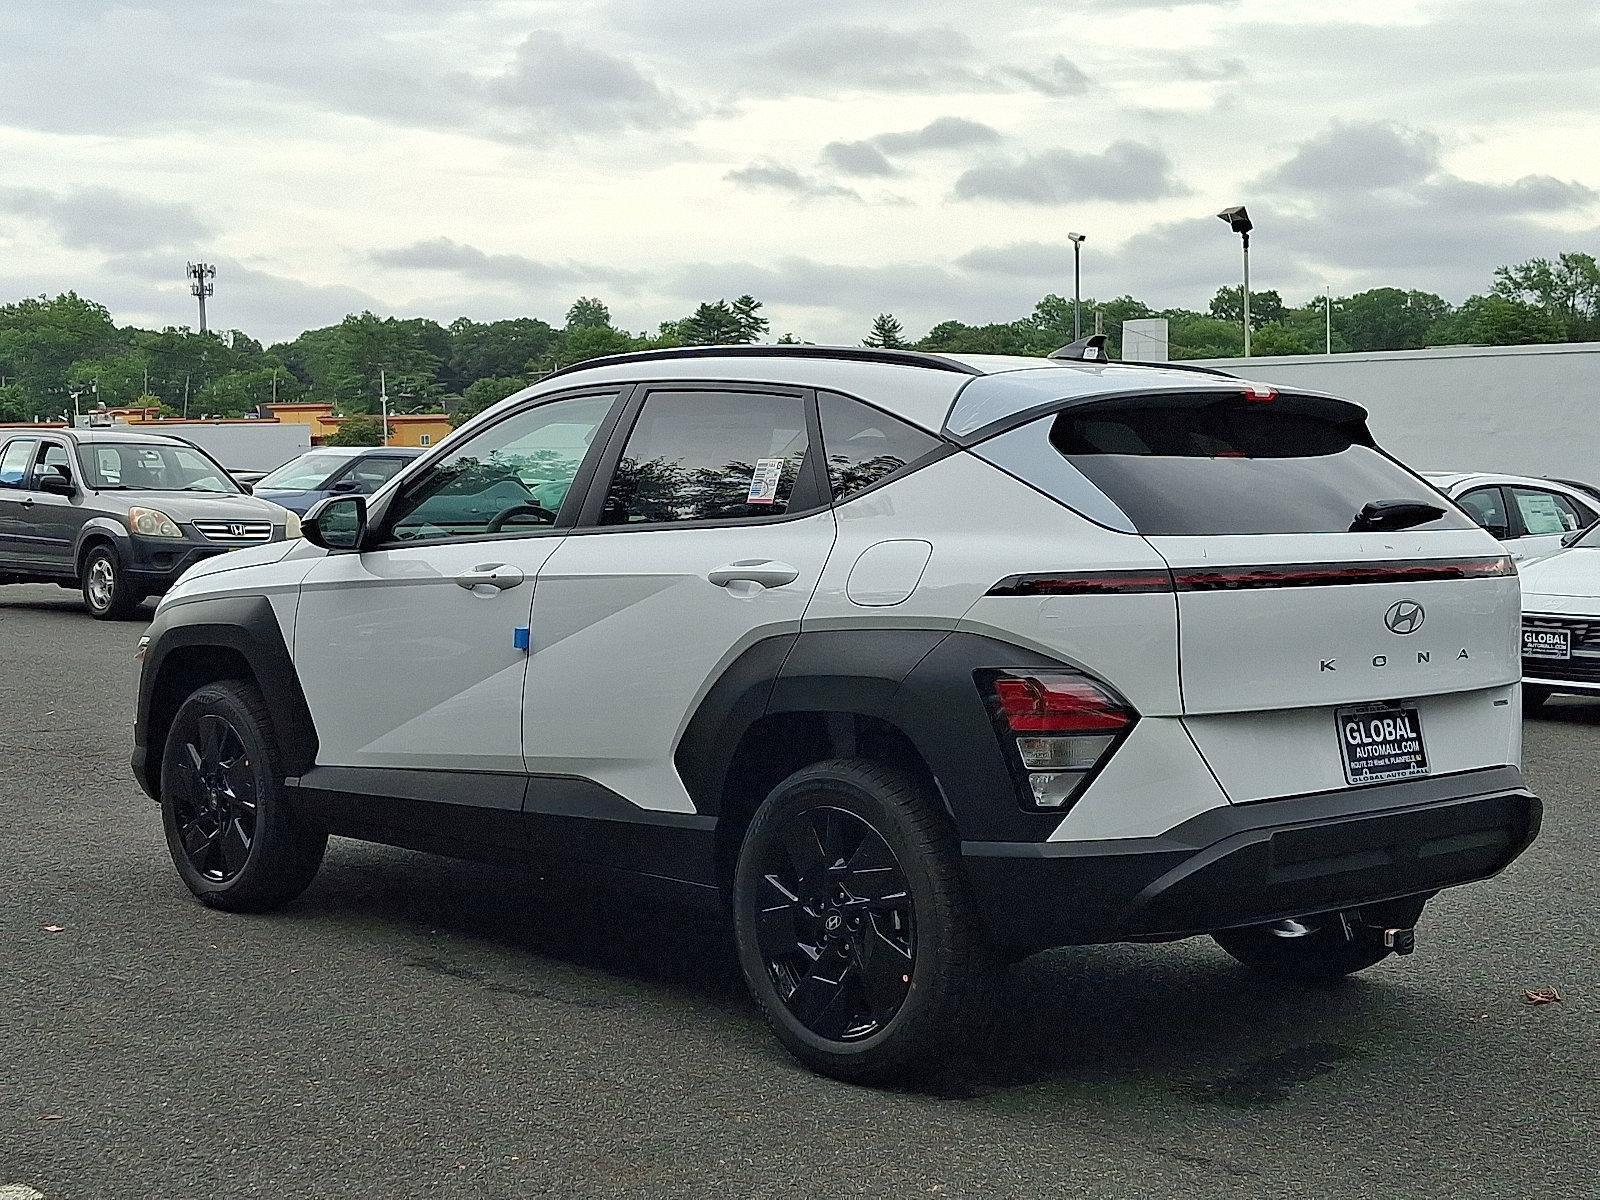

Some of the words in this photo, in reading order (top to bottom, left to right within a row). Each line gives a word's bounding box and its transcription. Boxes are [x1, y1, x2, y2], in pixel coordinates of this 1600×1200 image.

[1524, 633, 1566, 644] GLOBAL
[1320, 648, 1469, 671] KONA
[1346, 717, 1417, 745] GLOBAL
[1356, 741, 1419, 758] AUTOMALL.COM
[1351, 761, 1367, 769] ROUTE
